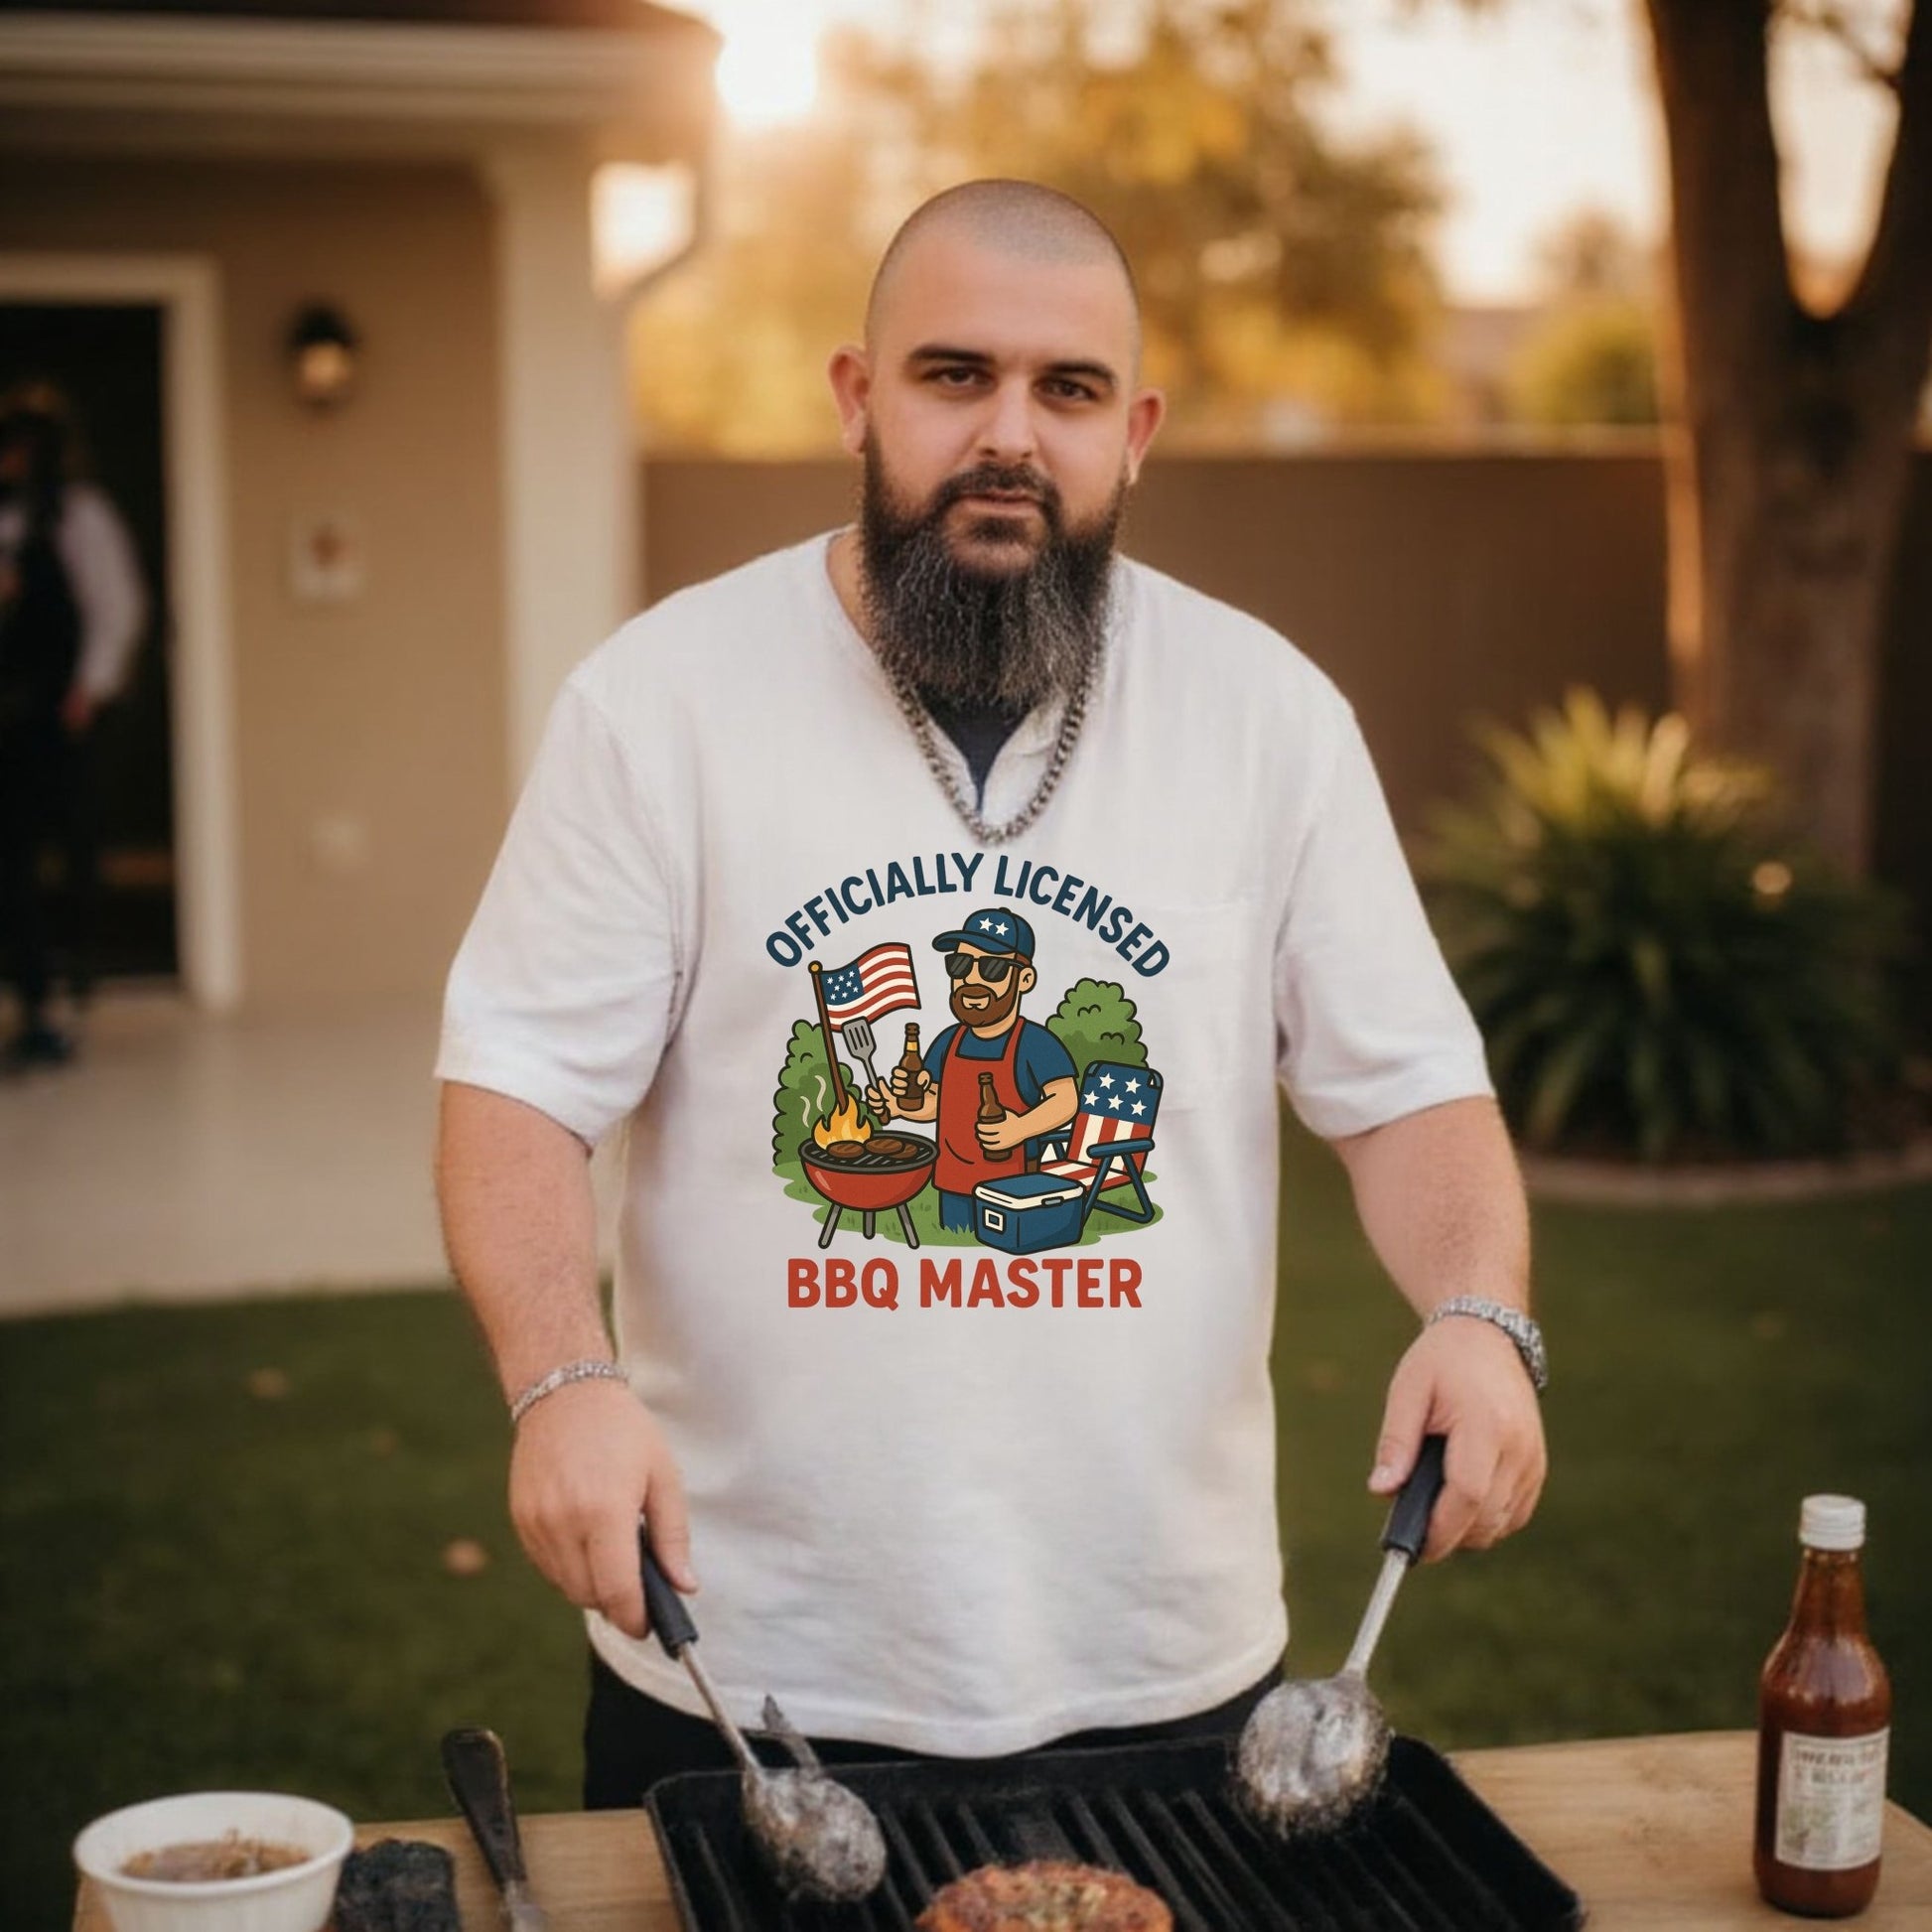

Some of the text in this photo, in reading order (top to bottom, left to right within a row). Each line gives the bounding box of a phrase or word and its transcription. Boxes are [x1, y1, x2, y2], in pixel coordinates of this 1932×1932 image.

[765, 852, 1171, 977] OFFICIALLY LICENSED
[787, 1258, 1143, 1311] BBQ MASTER
